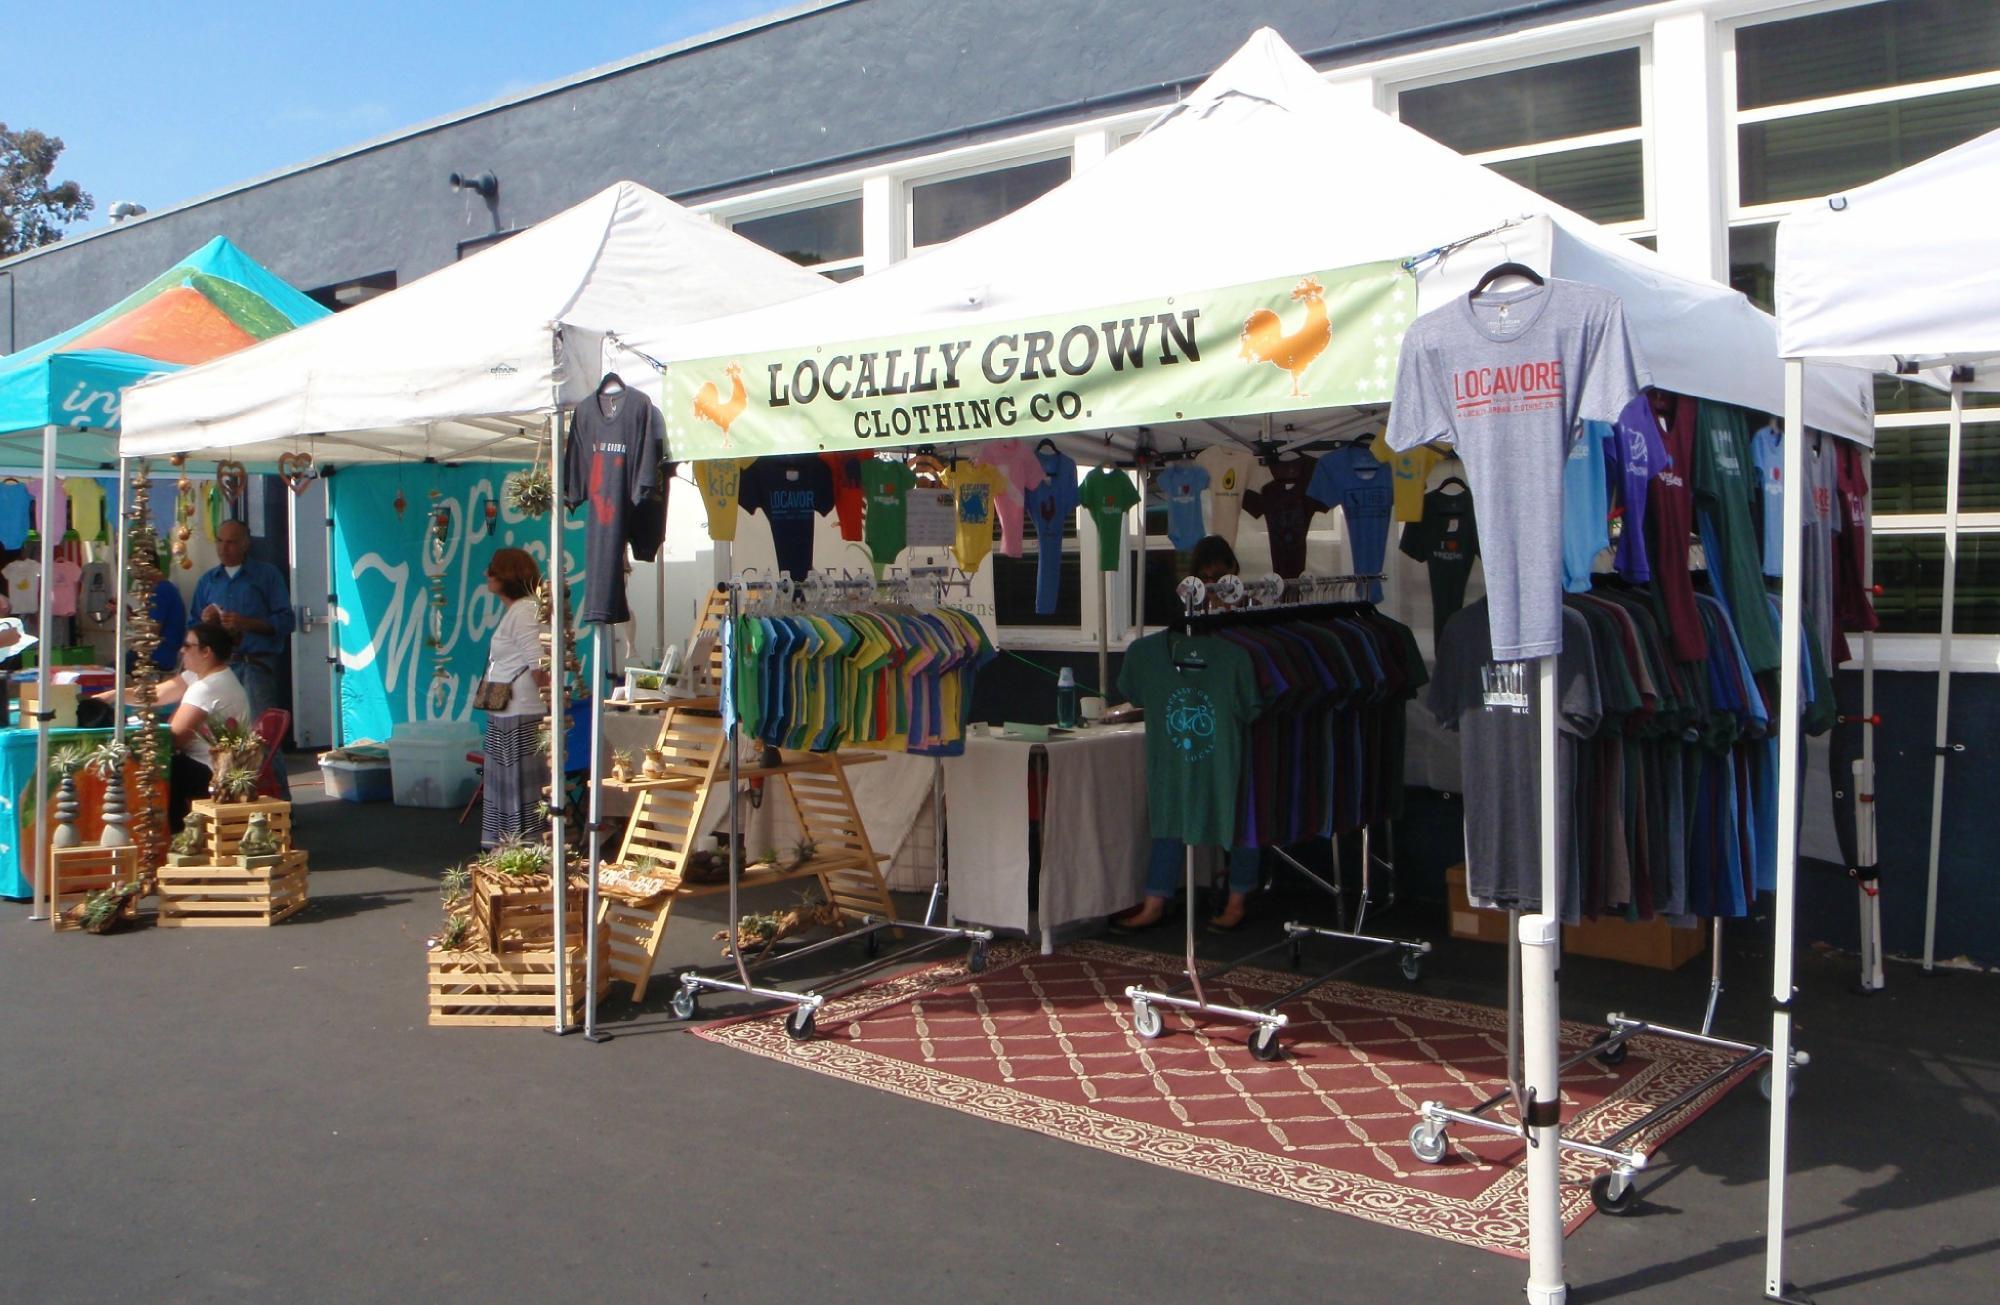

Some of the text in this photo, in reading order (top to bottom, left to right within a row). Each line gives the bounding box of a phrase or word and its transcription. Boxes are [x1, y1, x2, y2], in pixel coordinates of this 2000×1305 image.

[768, 308, 1201, 407] LOCALLY GROWN
[1454, 359, 1564, 401] LOCAVORE
[854, 390, 1093, 439] CLOTHING CO.
[708, 471, 738, 496] kid
[770, 490, 815, 509] LOCAVOR
